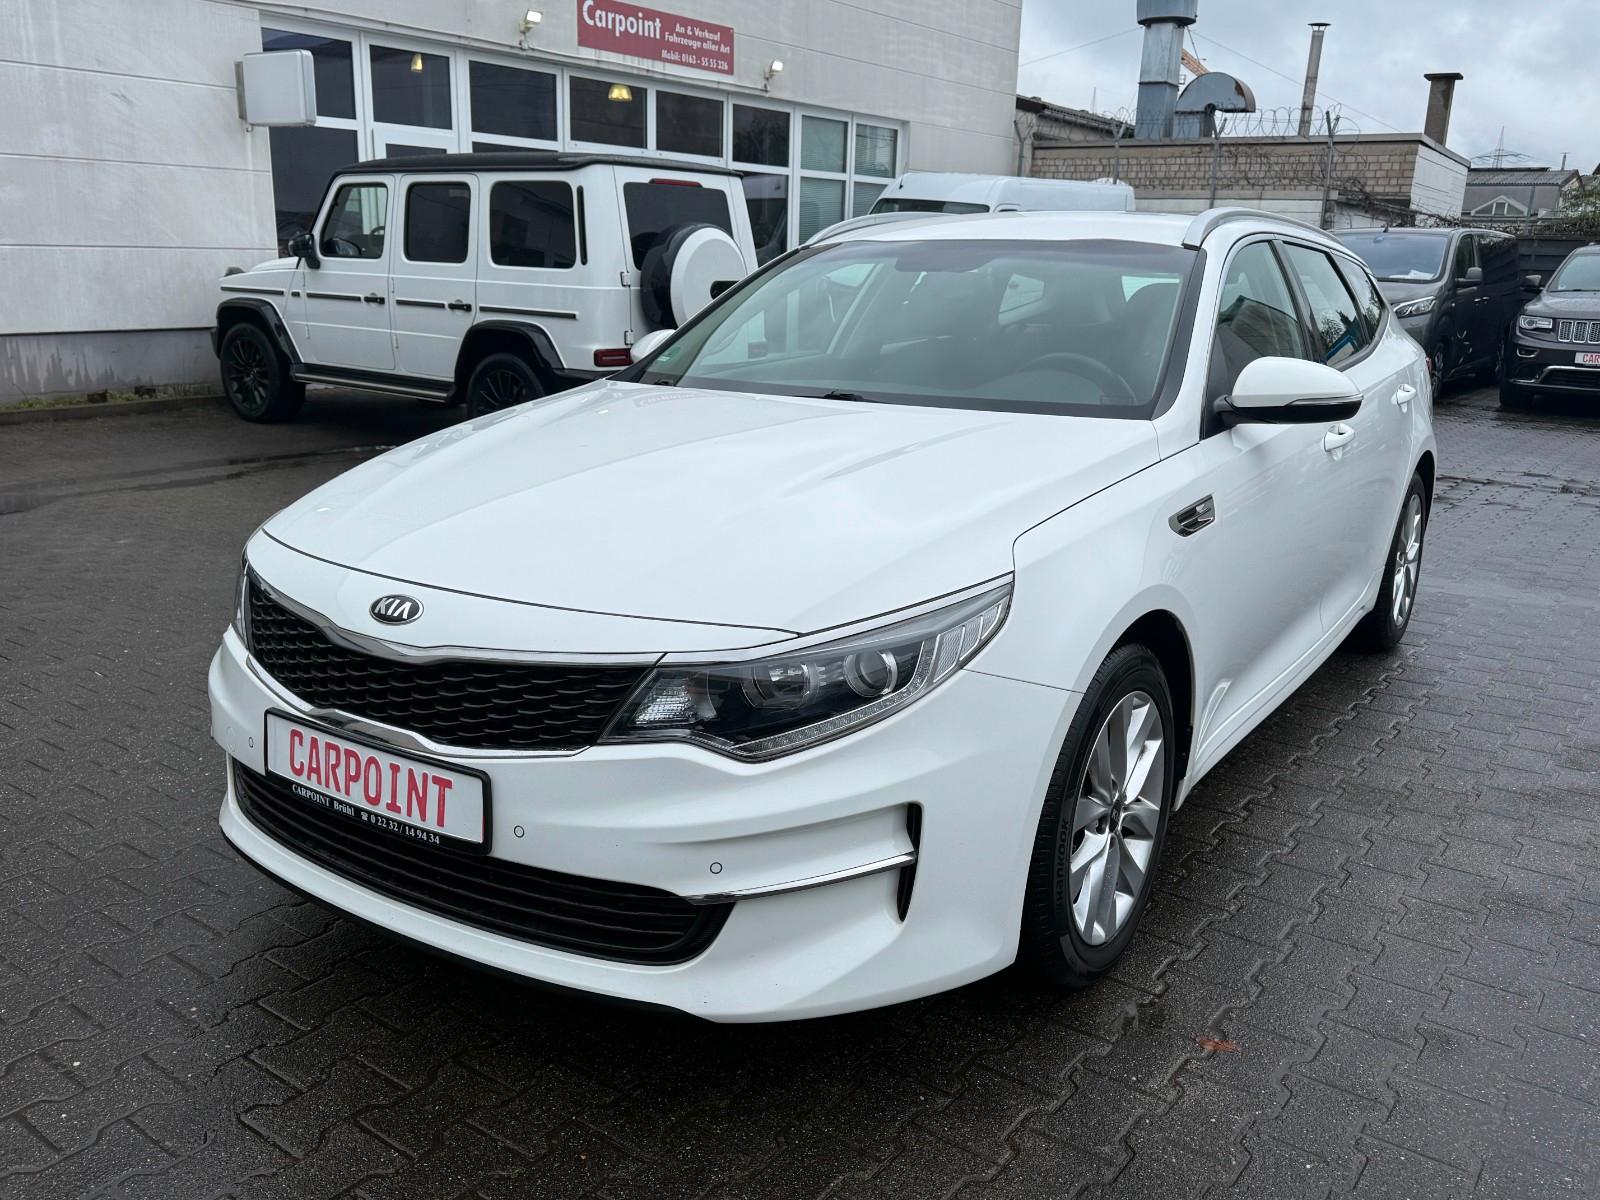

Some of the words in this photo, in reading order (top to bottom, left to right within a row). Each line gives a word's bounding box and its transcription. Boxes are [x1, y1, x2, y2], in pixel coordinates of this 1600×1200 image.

[582, 0, 662, 39] Carpoint
[664, 32, 701, 49] Fahrzeuge
[702, 40, 718, 51] aller
[720, 43, 730, 54] Art
[675, 23, 685, 33] An
[686, 26, 692, 35] &
[693, 27, 720, 41] Verkauf
[661, 49, 680, 61] Mobil:
[681, 53, 696, 65] 0163
[374, 598, 412, 619] KIA
[289, 728, 453, 828] CARPOINT
[292, 784, 329, 806] CARPOINT
[333, 800, 354, 816] Brühl
[370, 814, 376, 823] 0
[377, 816, 387, 828] 22
[388, 821, 398, 831] 32
[405, 826, 415, 836] 14
[416, 830, 427, 840] 94
[428, 833, 440, 844] 34
